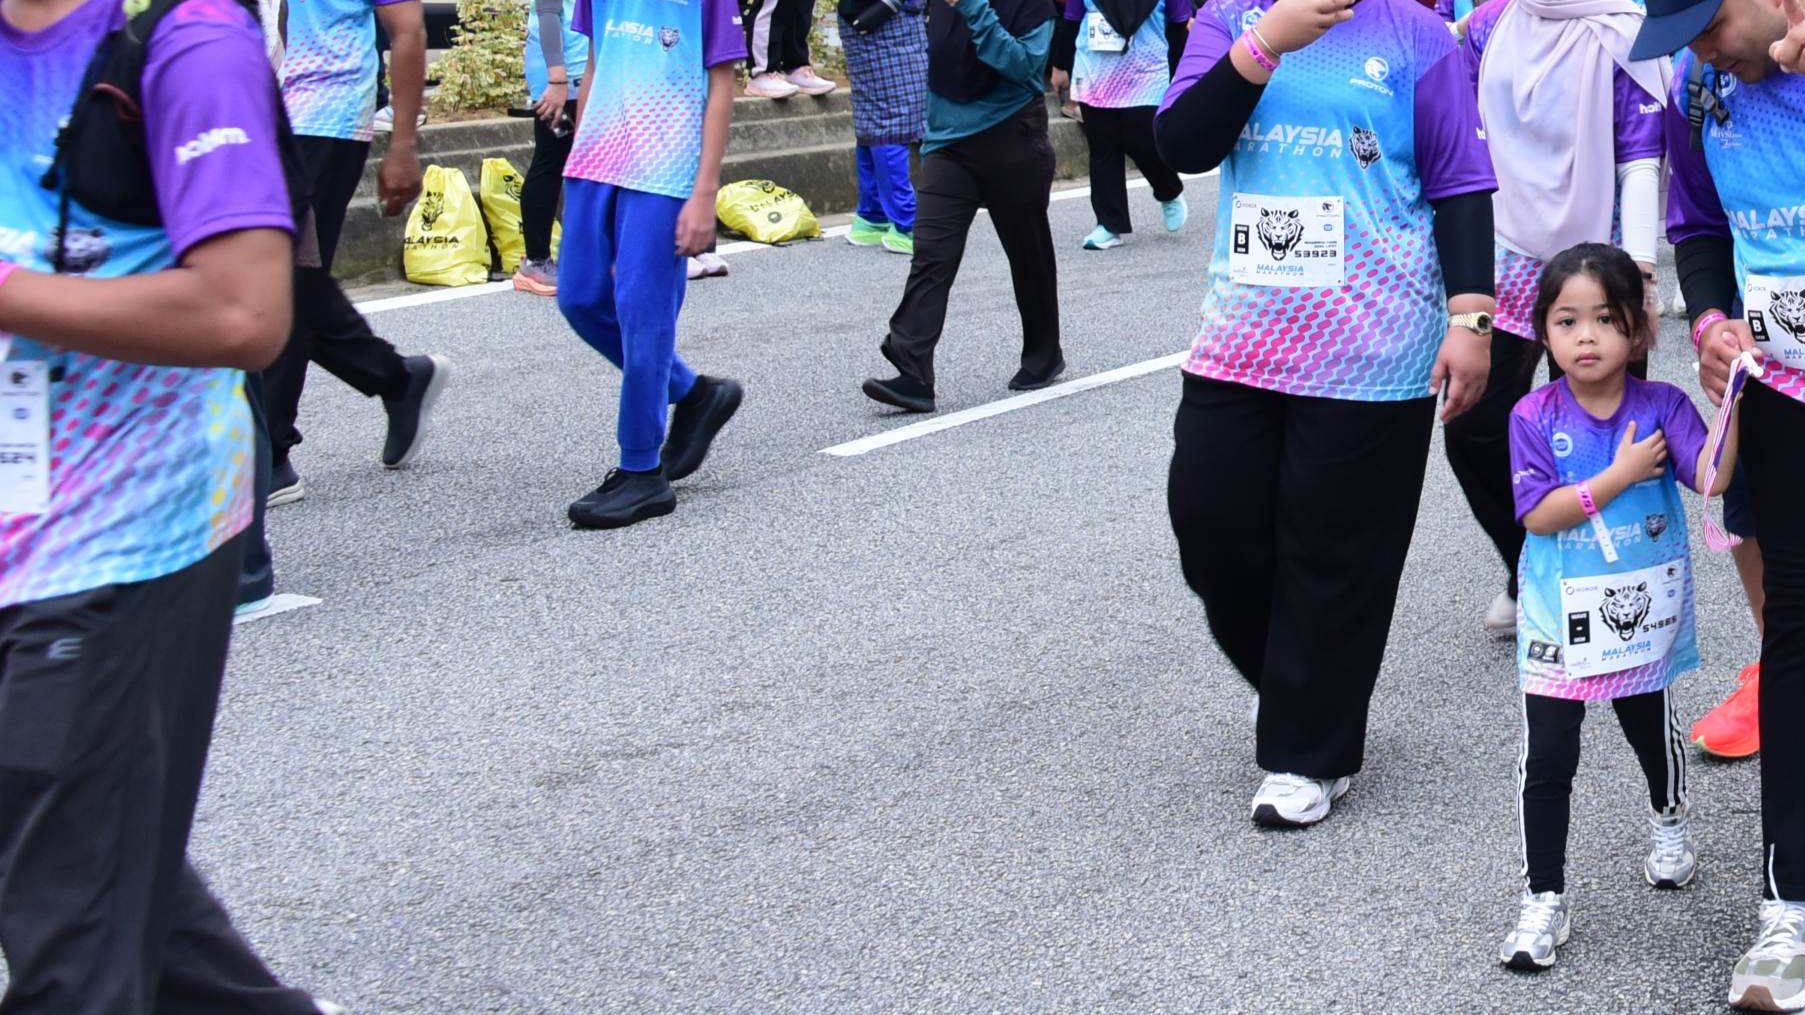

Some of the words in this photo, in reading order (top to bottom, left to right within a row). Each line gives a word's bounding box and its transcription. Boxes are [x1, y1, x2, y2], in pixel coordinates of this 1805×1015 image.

[1349, 78, 1394, 97] PROTON
[1239, 123, 1343, 148] ALAYSIA
[1233, 142, 1342, 158] ARATHON
[1238, 232, 1246, 243] B
[1256, 264, 1305, 273] MALAYSIA
[1752, 319, 1763, 333] B
[1601, 640, 1652, 657] MALAYSIA
